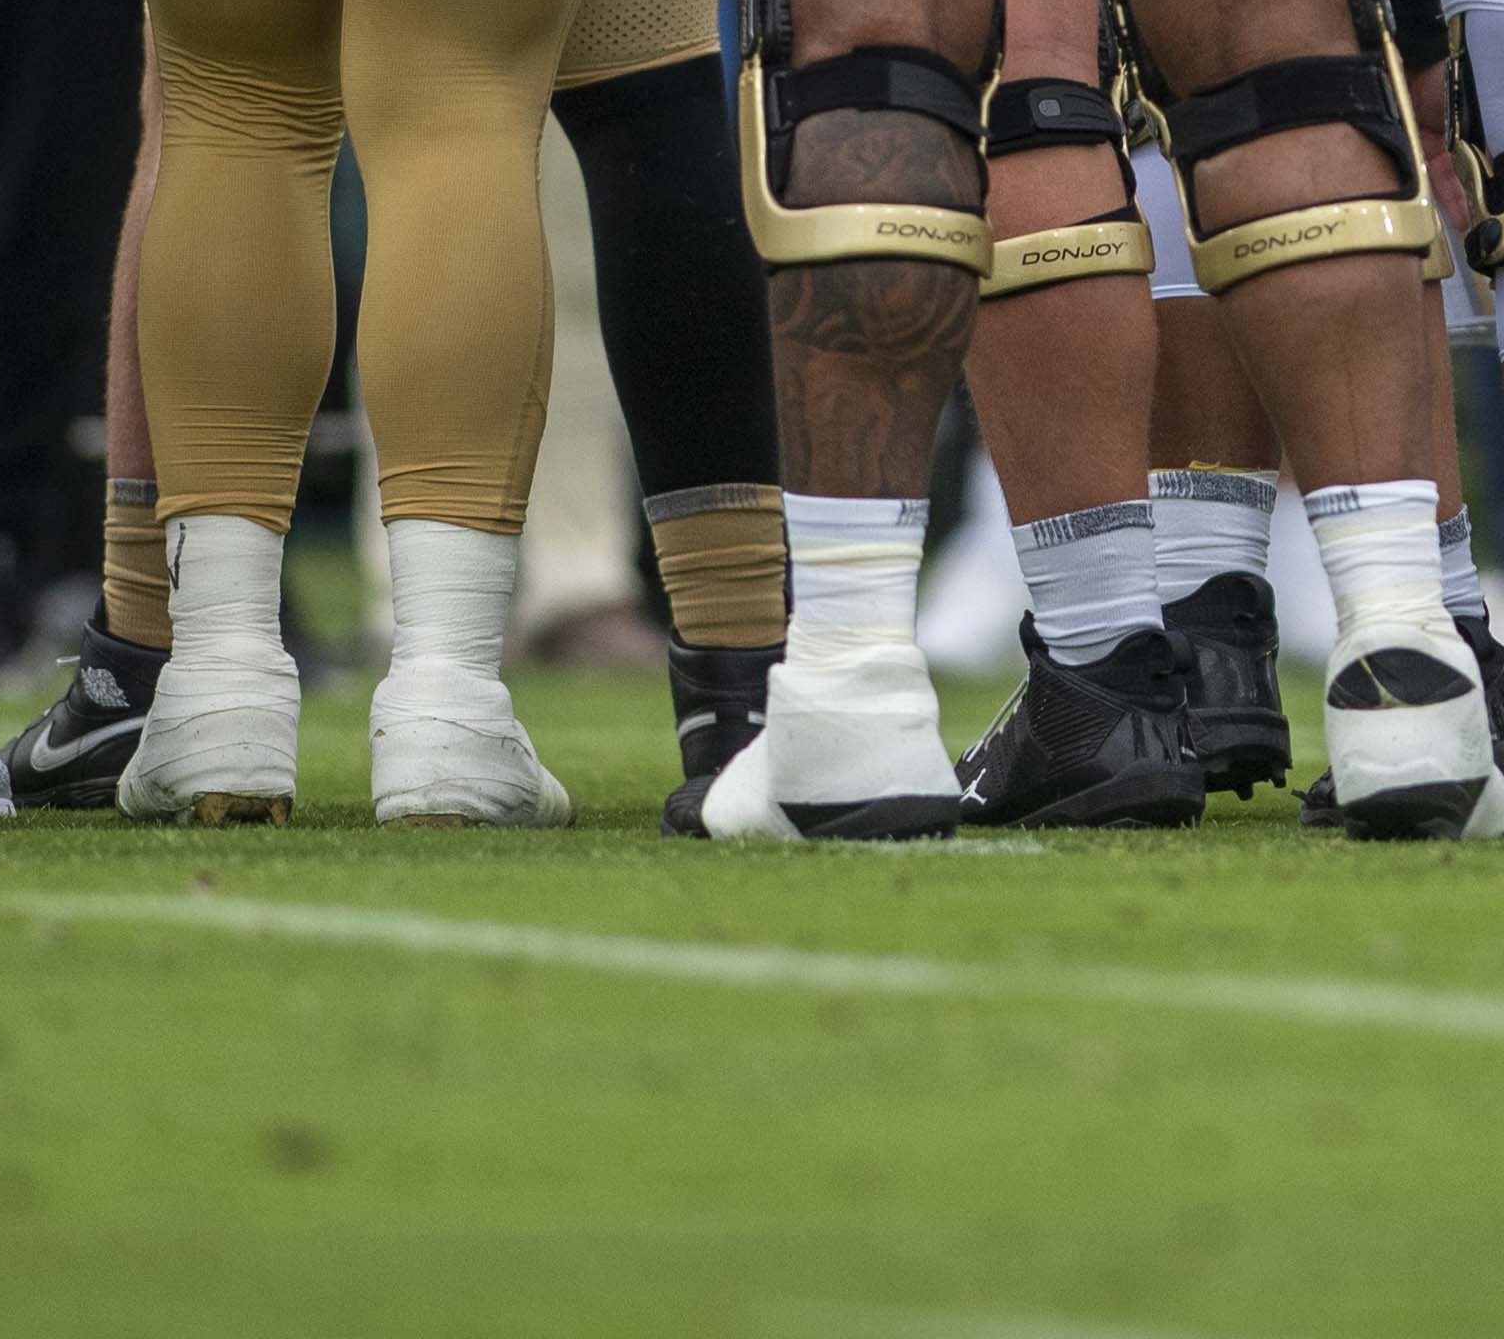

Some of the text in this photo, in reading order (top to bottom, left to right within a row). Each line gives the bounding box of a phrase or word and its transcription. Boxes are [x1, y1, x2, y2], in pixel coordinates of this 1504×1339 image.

[874, 222, 980, 245] DONJOY
[1234, 219, 1342, 258] DONJOY
[1021, 241, 1125, 266] DONJOY
